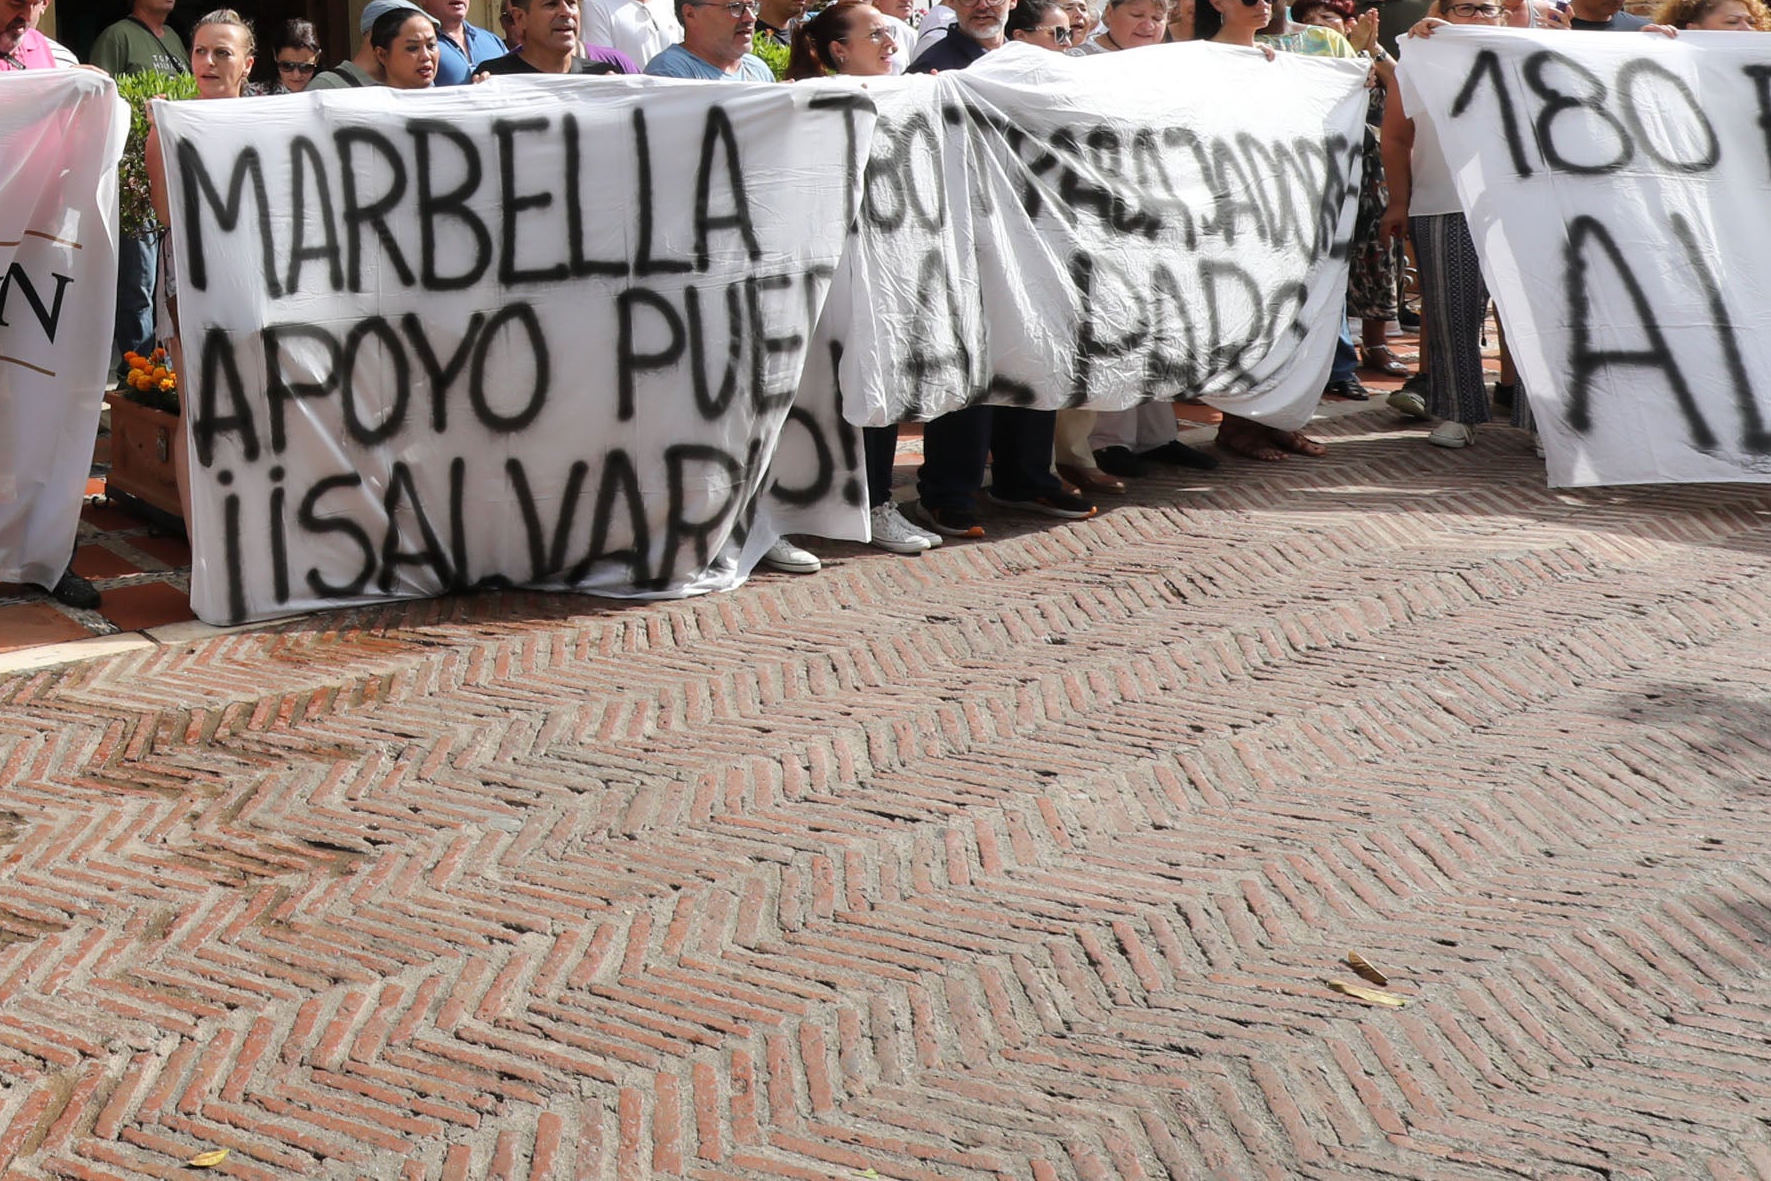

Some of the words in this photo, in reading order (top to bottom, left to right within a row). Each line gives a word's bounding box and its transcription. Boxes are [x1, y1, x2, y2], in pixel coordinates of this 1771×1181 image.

[1451, 48, 1721, 179] 180
[177, 104, 763, 297] MARBELLA
[193, 300, 551, 468] APOYO
